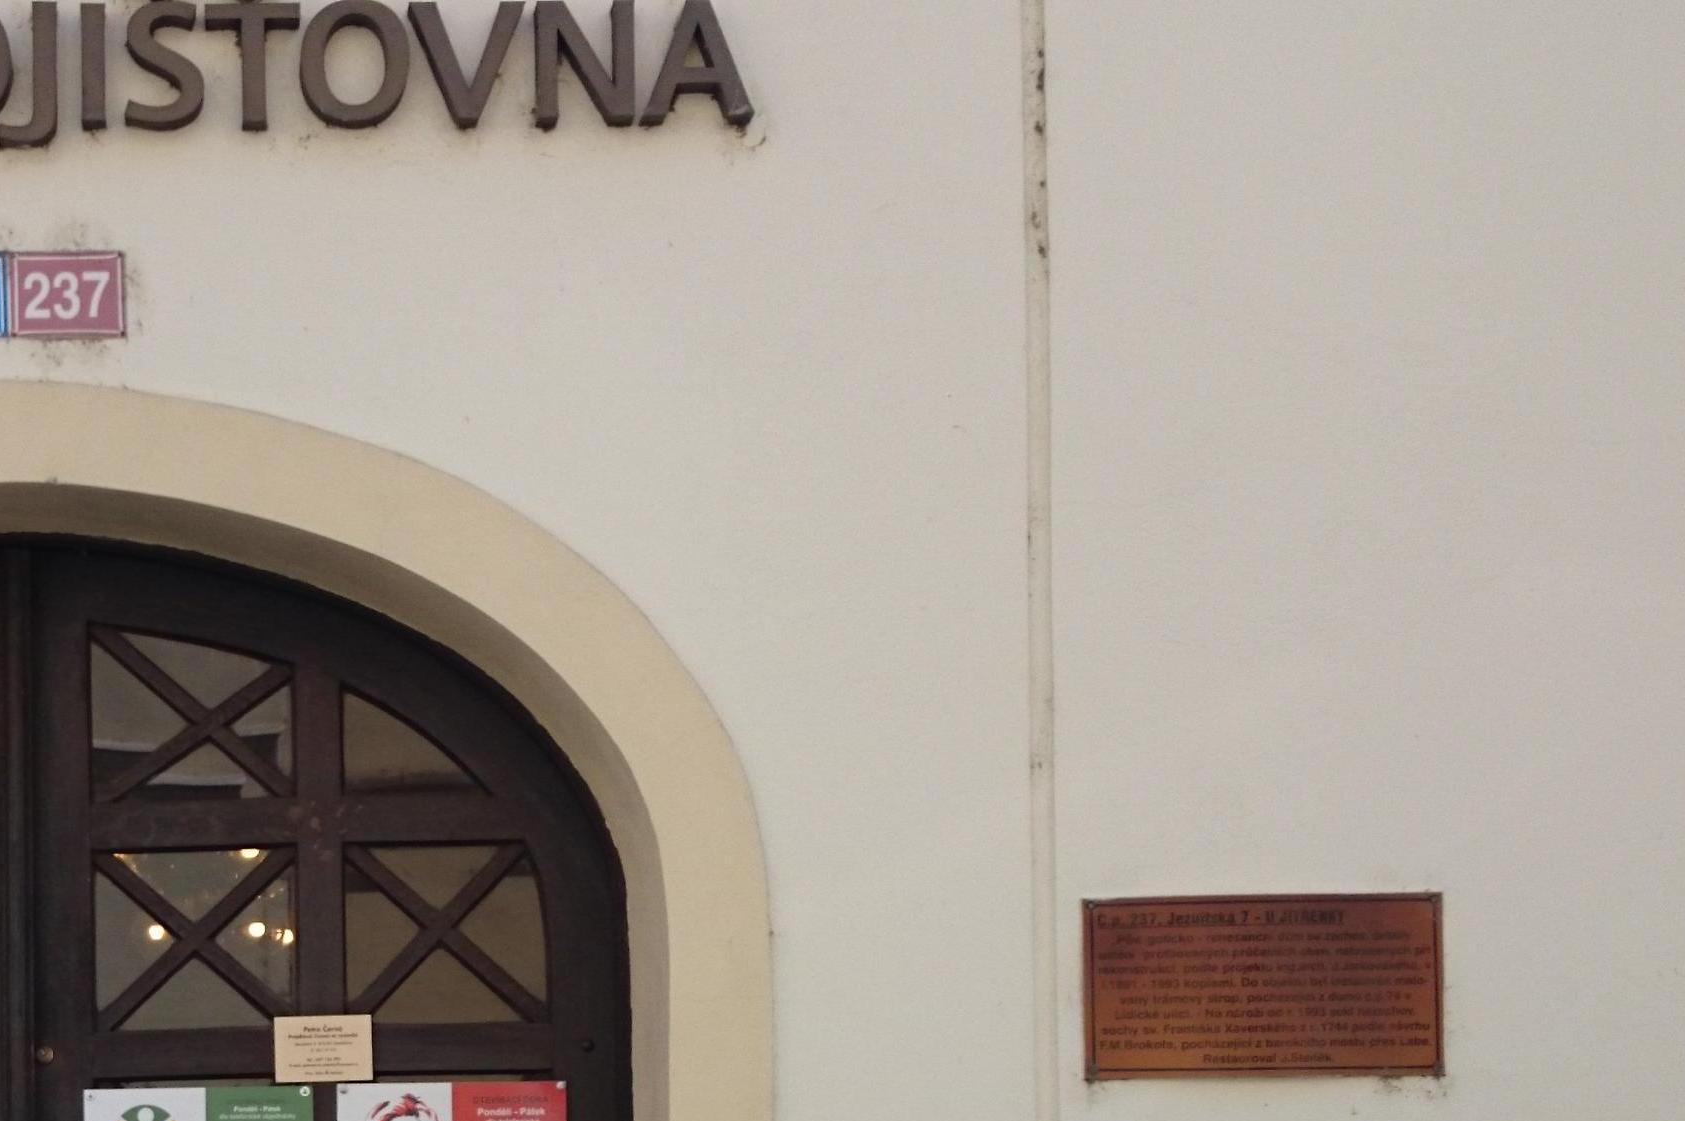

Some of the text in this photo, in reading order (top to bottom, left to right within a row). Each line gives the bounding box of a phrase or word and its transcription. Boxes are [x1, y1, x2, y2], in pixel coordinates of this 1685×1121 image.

[23, 271, 110, 320] 237
[1241, 976, 1259, 987] Do
[477, 1107, 512, 1117] Pondělí
